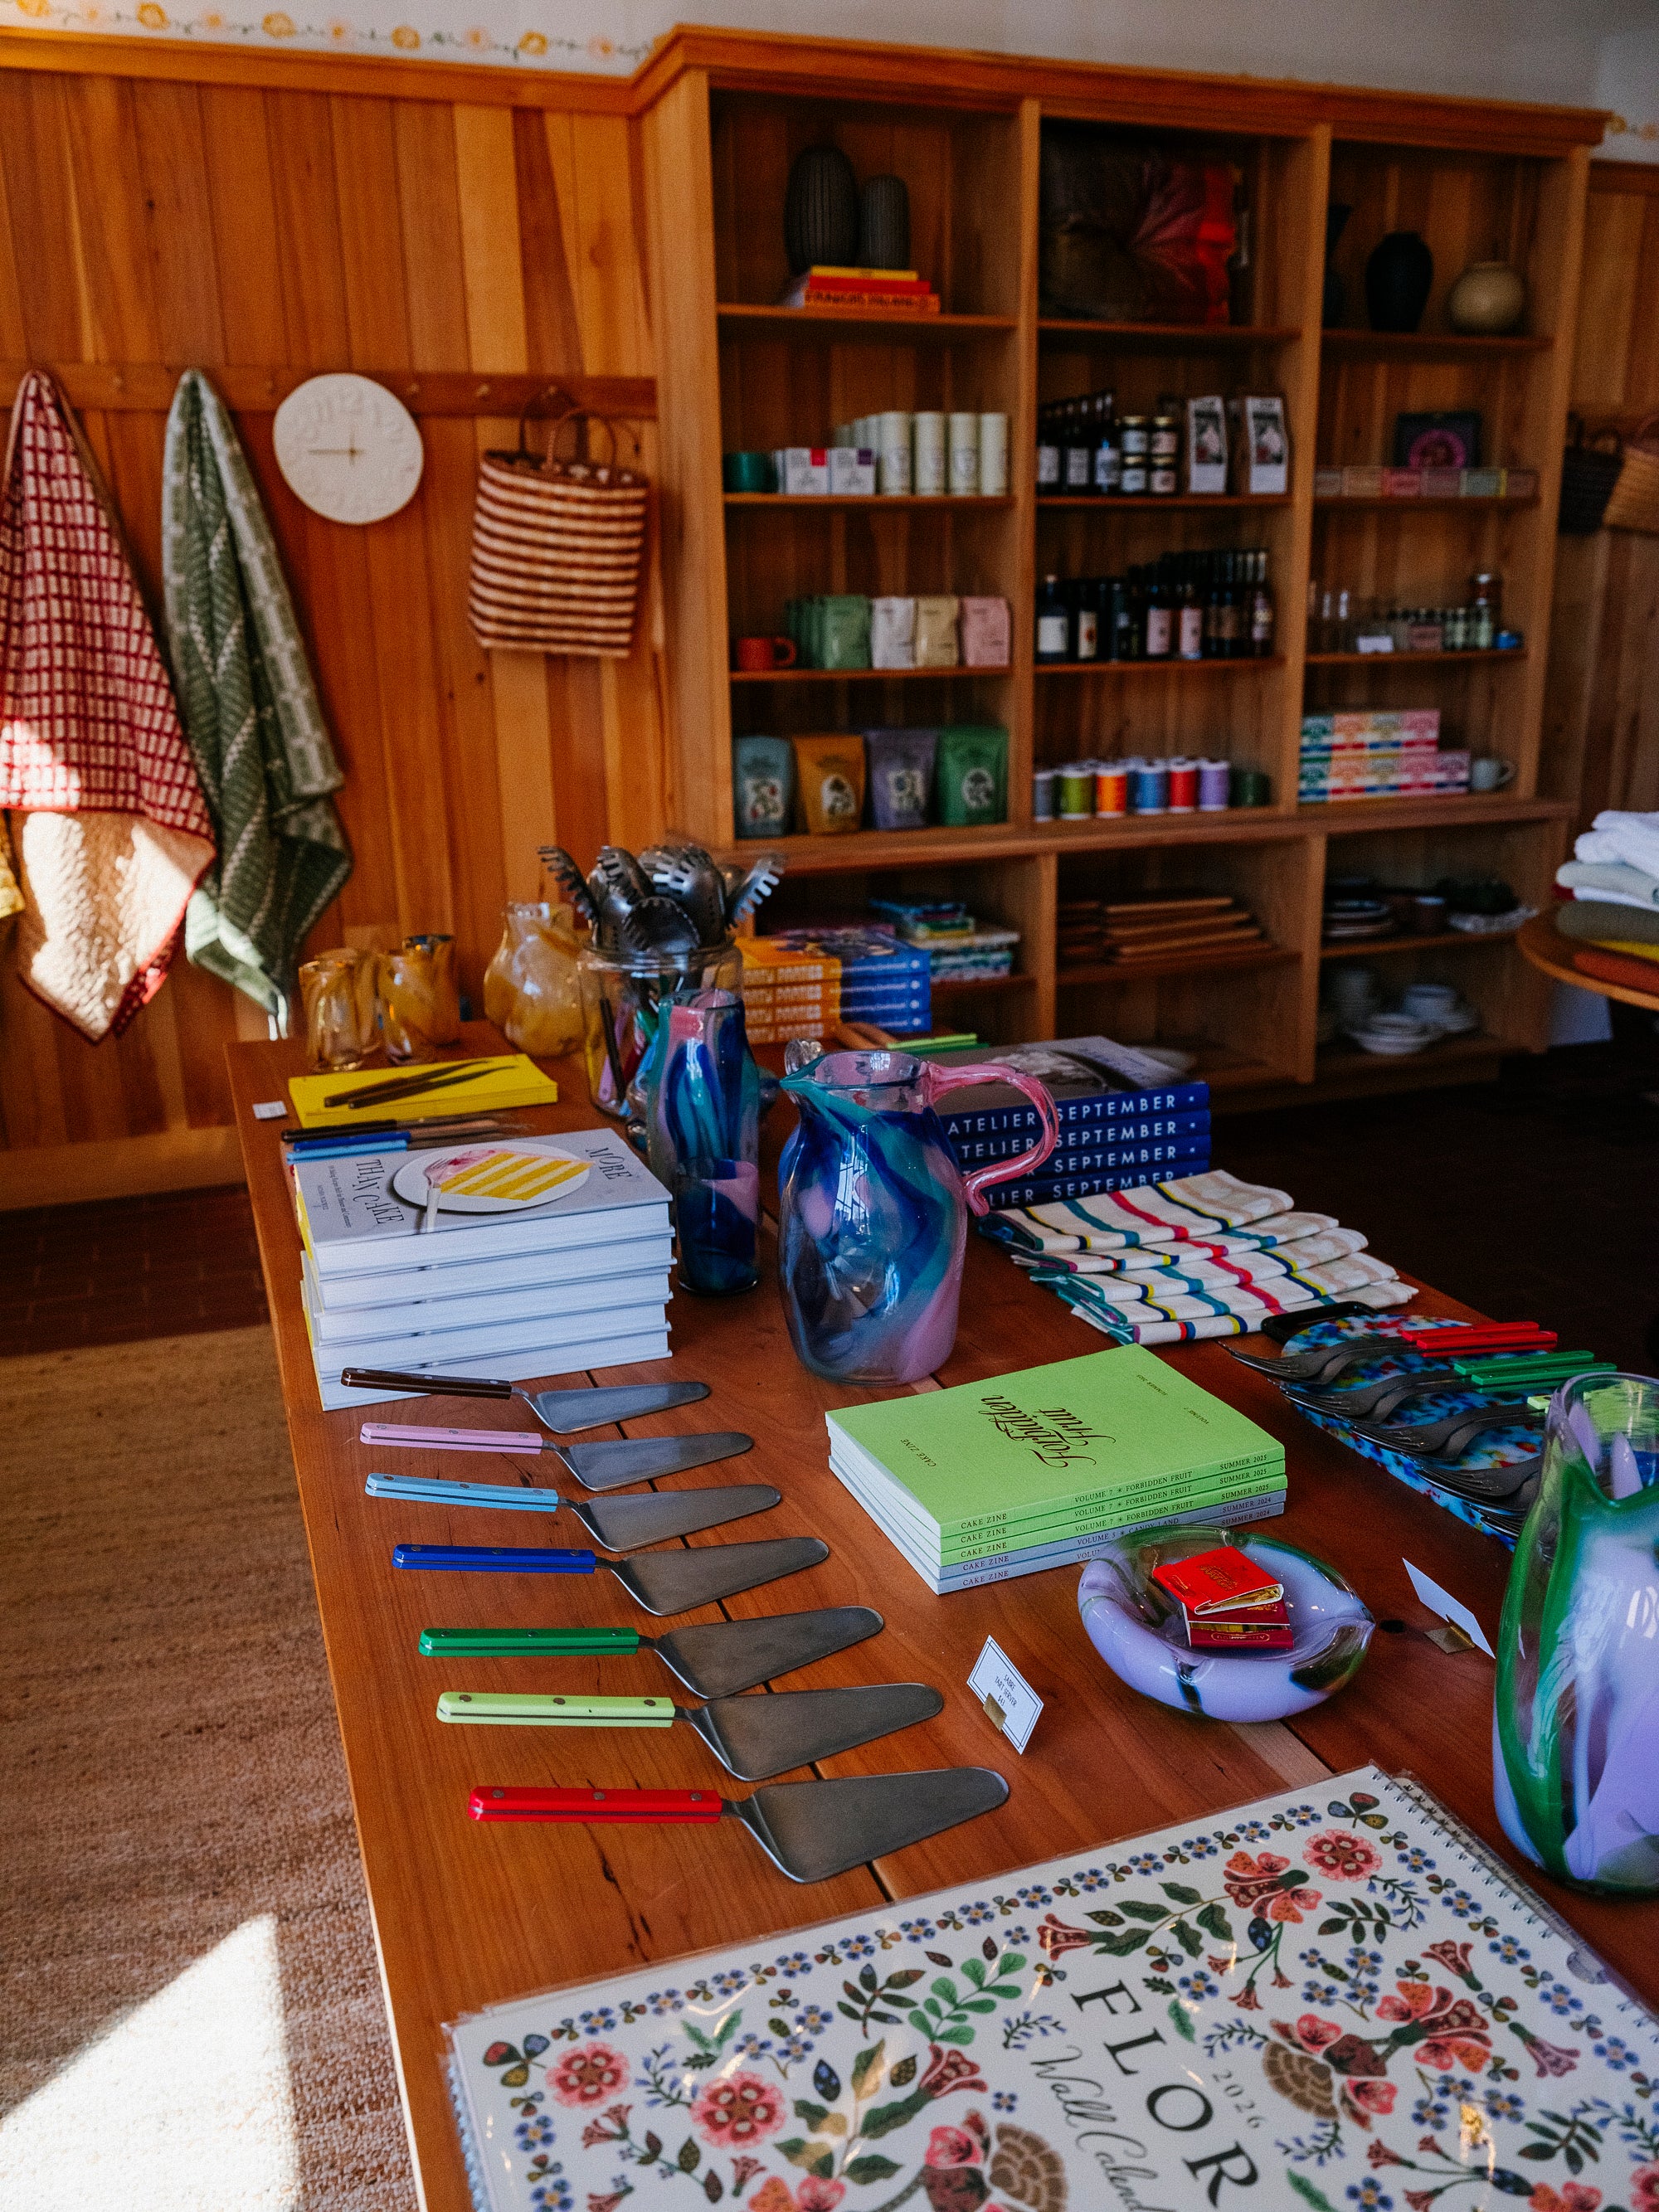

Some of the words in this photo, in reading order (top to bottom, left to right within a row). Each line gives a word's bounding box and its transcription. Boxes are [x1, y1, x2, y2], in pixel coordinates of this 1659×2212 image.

[947, 1112, 1035, 1135] ATELIER
[1057, 1095, 1175, 1121] SEPTEMBER
[961, 1138, 1034, 1159] TELIER
[1054, 1121, 1175, 1148] SEPTEMBER
[586, 1148, 632, 1179] MORE
[1054, 1146, 1175, 1173] SEPTEMBER
[352, 1159, 385, 1191] THAN
[989, 1189, 1034, 1207] LIER
[353, 1194, 404, 1224] CAKE
[978, 1394, 1097, 1468] Forbidden
[1034, 1407, 1117, 1446] Fruit
[900, 1438, 920, 1452] ZINE
[916, 1452, 937, 1467] CAKE
[1219, 1458, 1250, 1470] SUMMER
[1253, 1455, 1267, 1463] 2025
[1219, 1472, 1250, 1485] SUMMER
[1253, 1469, 1267, 1477] 2025
[1074, 1490, 1107, 1503] VOLUME
[1126, 1477, 1168, 1492] FORBIDDEN
[1170, 1471, 1193, 1482] FRUIT
[1221, 1487, 1253, 1500] SUMMER
[1255, 1485, 1269, 1493] 2025
[1074, 1505, 1106, 1517] VOLUME
[1126, 1490, 1168, 1505] FORBIDDEN
[1170, 1485, 1192, 1495] FRUIT
[1223, 1500, 1254, 1513] SUMMER
[1257, 1497, 1271, 1505] 2024
[961, 1518, 983, 1529] CAKE
[986, 1513, 1007, 1523] ZINE
[1075, 1519, 1107, 1532] VOLUME
[1126, 1505, 1169, 1521] FORBIDDEN
[1172, 1501, 1194, 1512] FRUIT
[1221, 1514, 1253, 1525] SUMMER
[1256, 1510, 1270, 1519] 2024
[961, 1532, 983, 1543] CAKE
[986, 1528, 1007, 1538] ZINE
[1078, 1533, 1109, 1545] VOLUME
[961, 1547, 983, 1558] CAKE
[986, 1543, 1007, 1553] ZINE
[1077, 1549, 1100, 1559] VOLU
[963, 1560, 985, 1571] CAKE
[989, 1555, 1010, 1566] ZINE
[962, 1575, 985, 1586] CAKE
[988, 1570, 1009, 1581] ZINE
[1003, 1674, 1016, 1691] SABRE
[995, 1676, 1005, 1691] TART
[1004, 1688, 1017, 1709] SERVER
[1030, 2045, 1117, 2128] Wall
[1070, 1979, 1258, 2209] FLOR
[1212, 2069, 1262, 2129] 2026
